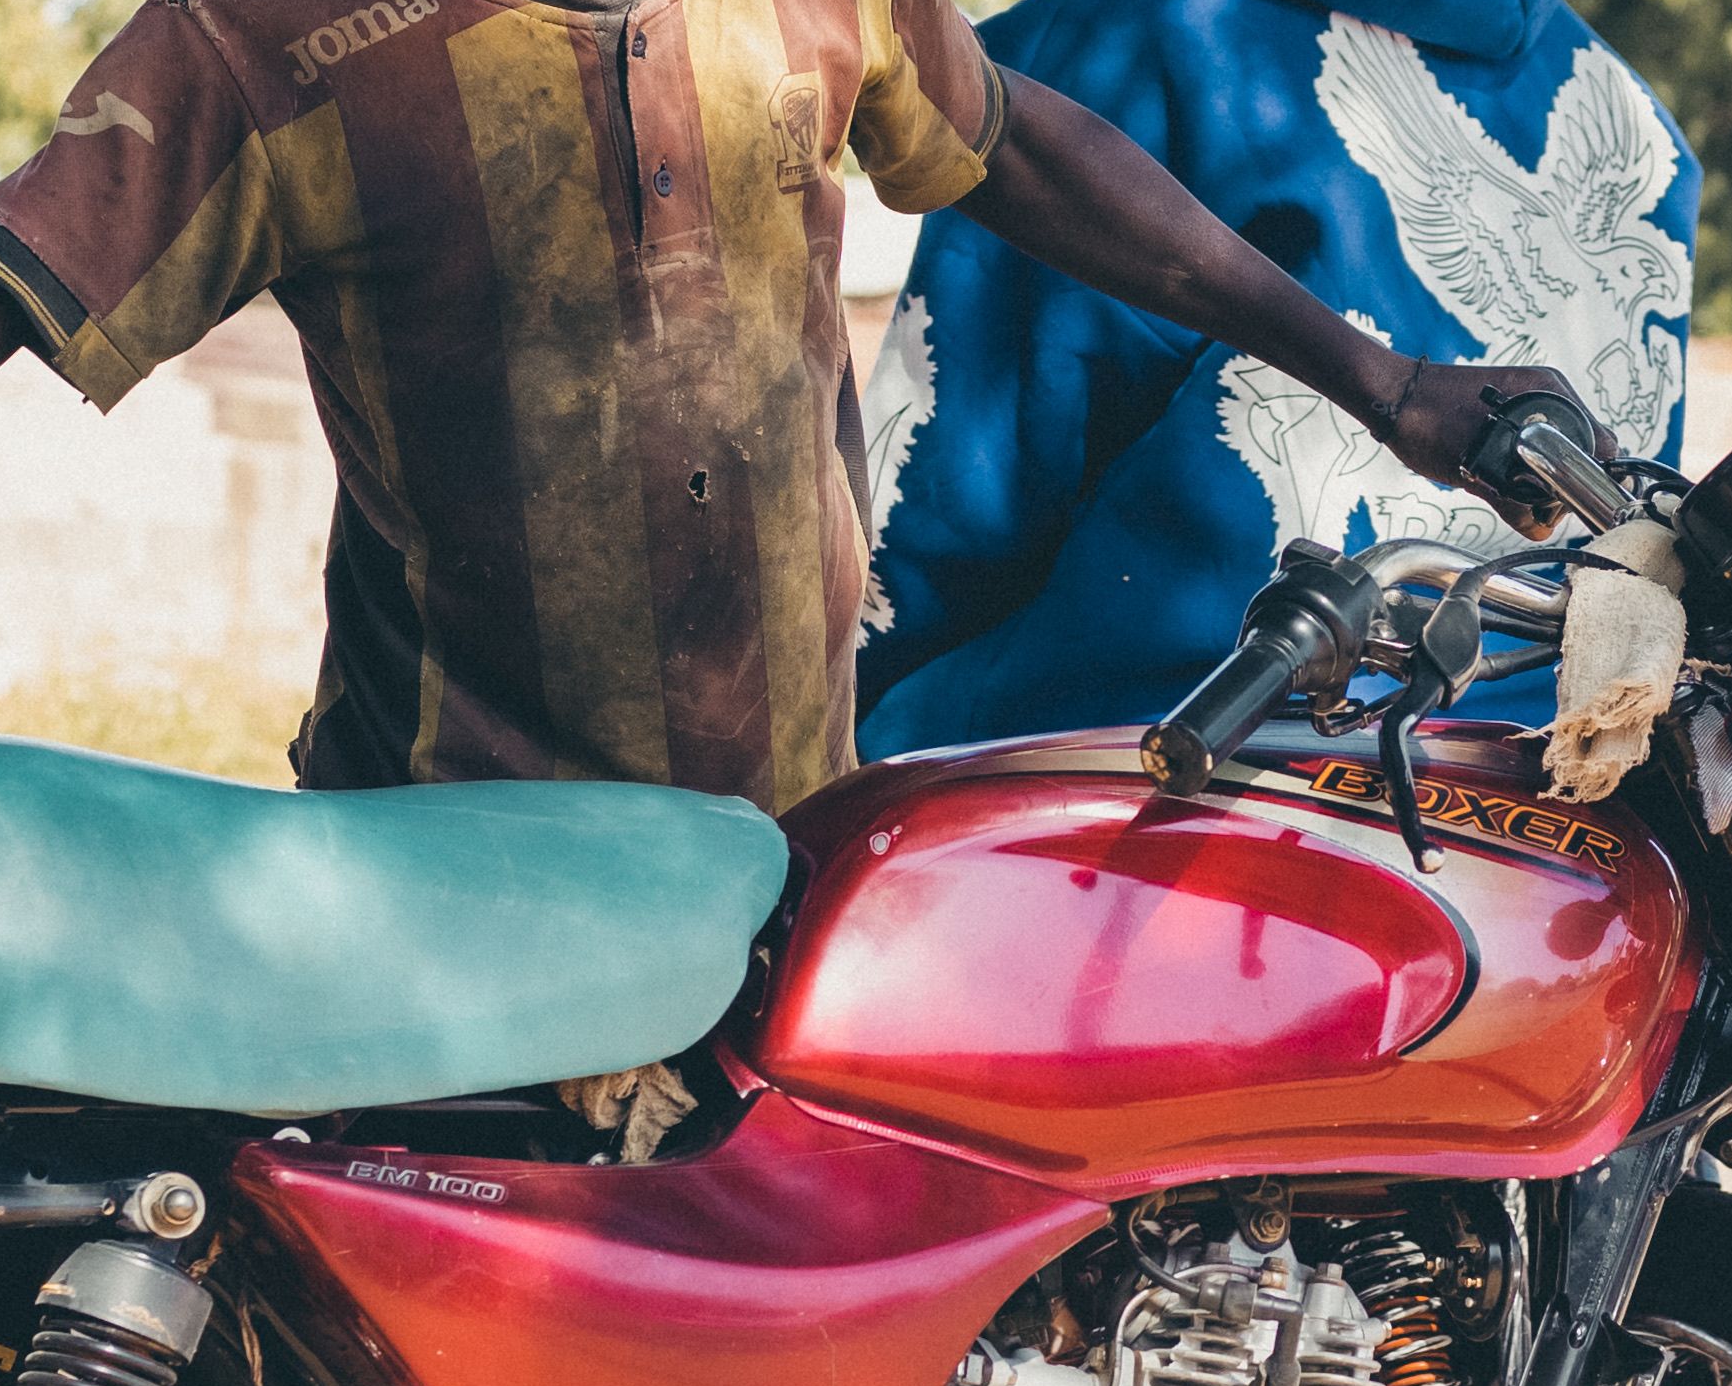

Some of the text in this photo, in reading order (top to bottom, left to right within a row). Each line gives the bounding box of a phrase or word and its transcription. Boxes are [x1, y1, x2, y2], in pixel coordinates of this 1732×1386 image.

[1310, 760, 1627, 874] BOXER
[345, 1161, 509, 1205] BM 100
